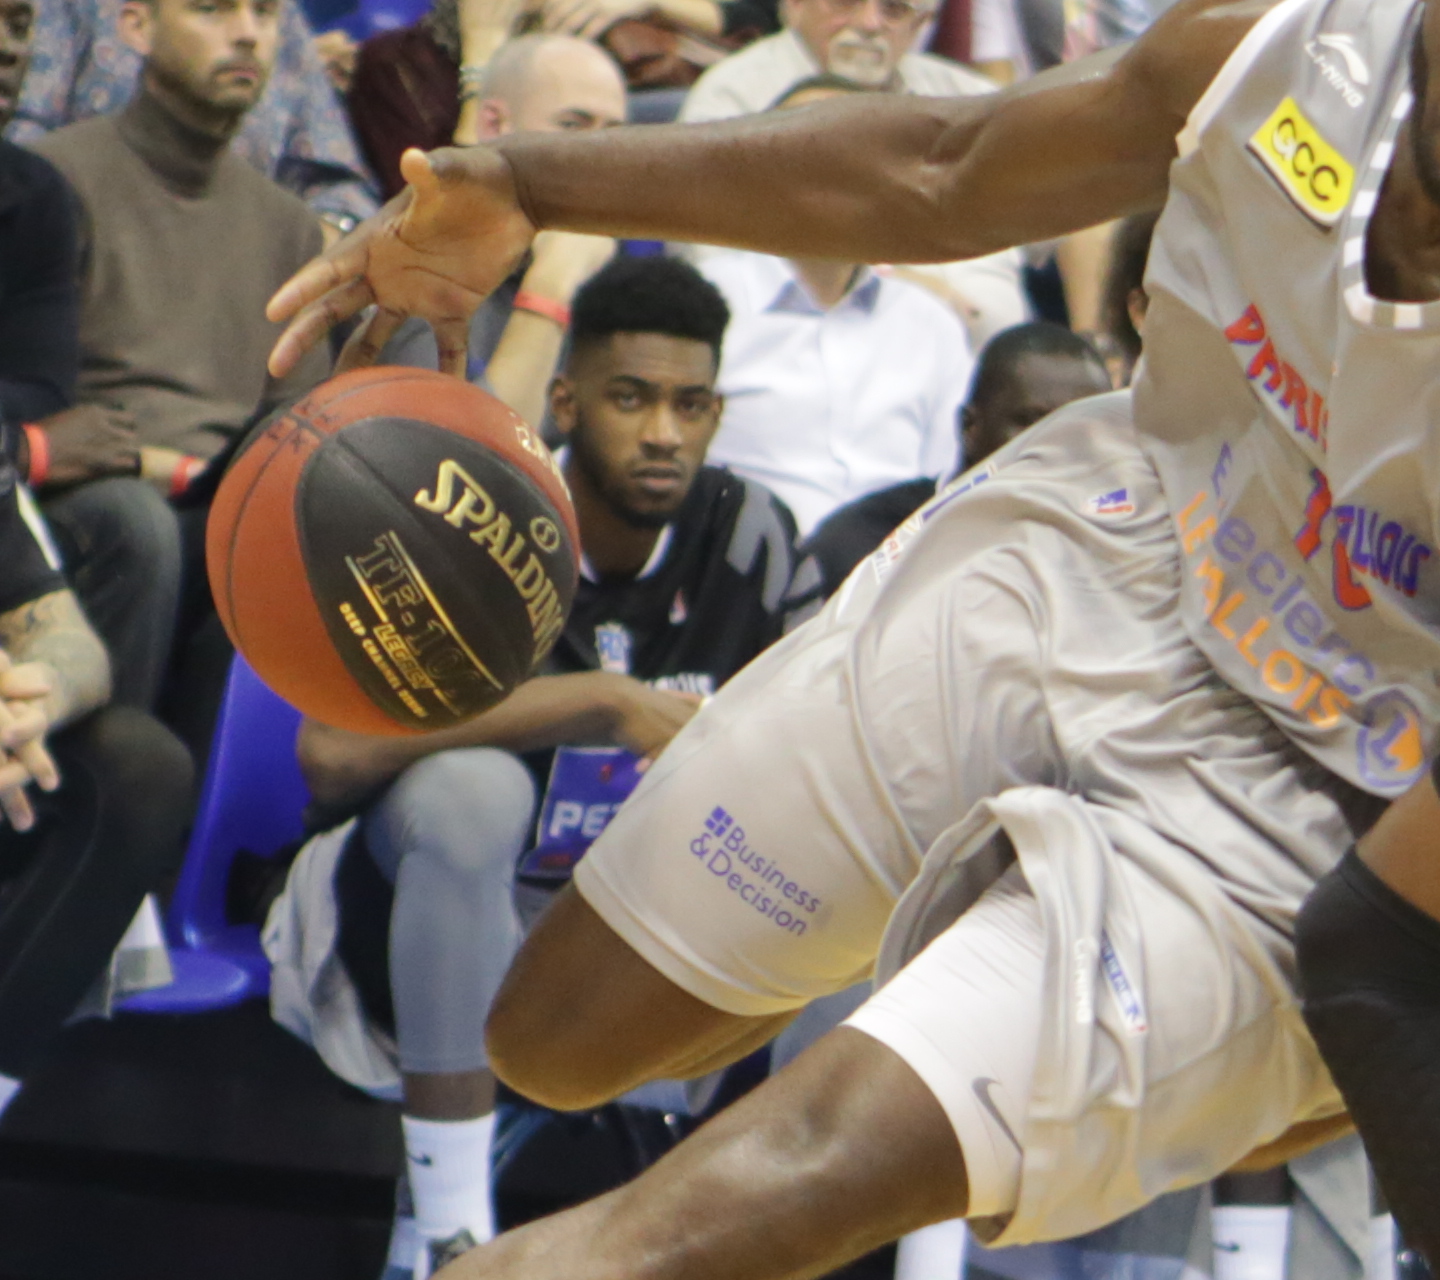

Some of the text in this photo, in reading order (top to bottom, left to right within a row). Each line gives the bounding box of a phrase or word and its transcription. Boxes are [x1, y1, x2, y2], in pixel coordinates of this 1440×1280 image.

[1304, 41, 1365, 109] LI-NING
[689, 832, 807, 937] & Decision
[724, 825, 822, 914] Business
